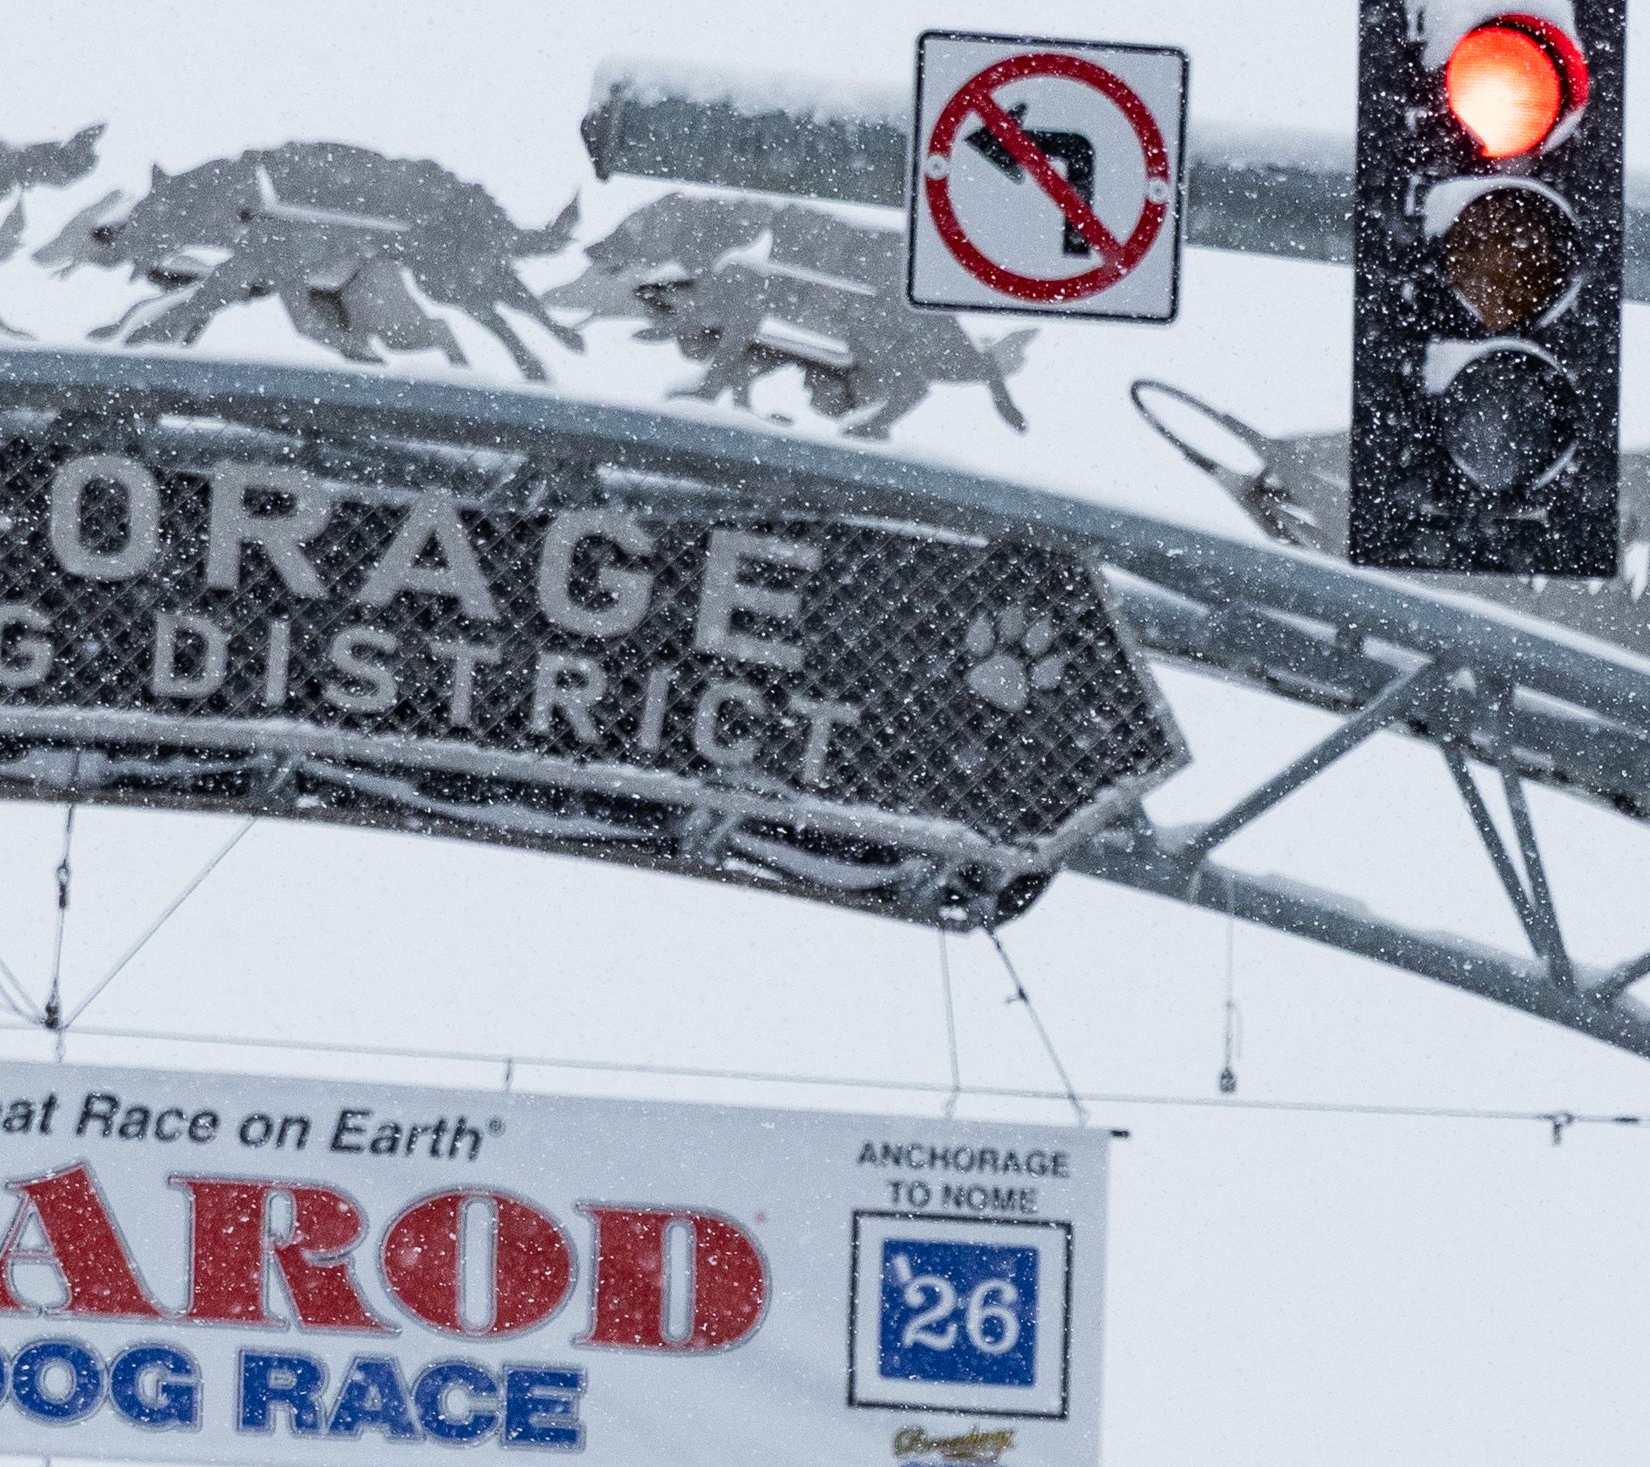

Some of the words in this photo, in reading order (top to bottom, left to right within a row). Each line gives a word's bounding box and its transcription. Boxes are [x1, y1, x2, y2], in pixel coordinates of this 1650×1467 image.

[150, 609, 864, 788] DISTRICT
[76, 1093, 221, 1146] Race
[240, 1111, 317, 1150] on
[856, 1141, 1072, 1179] ANCHORAGE
[888, 1179, 933, 1208] TO
[941, 1183, 1039, 1214] NOME
[236, 1344, 588, 1454] RACE
